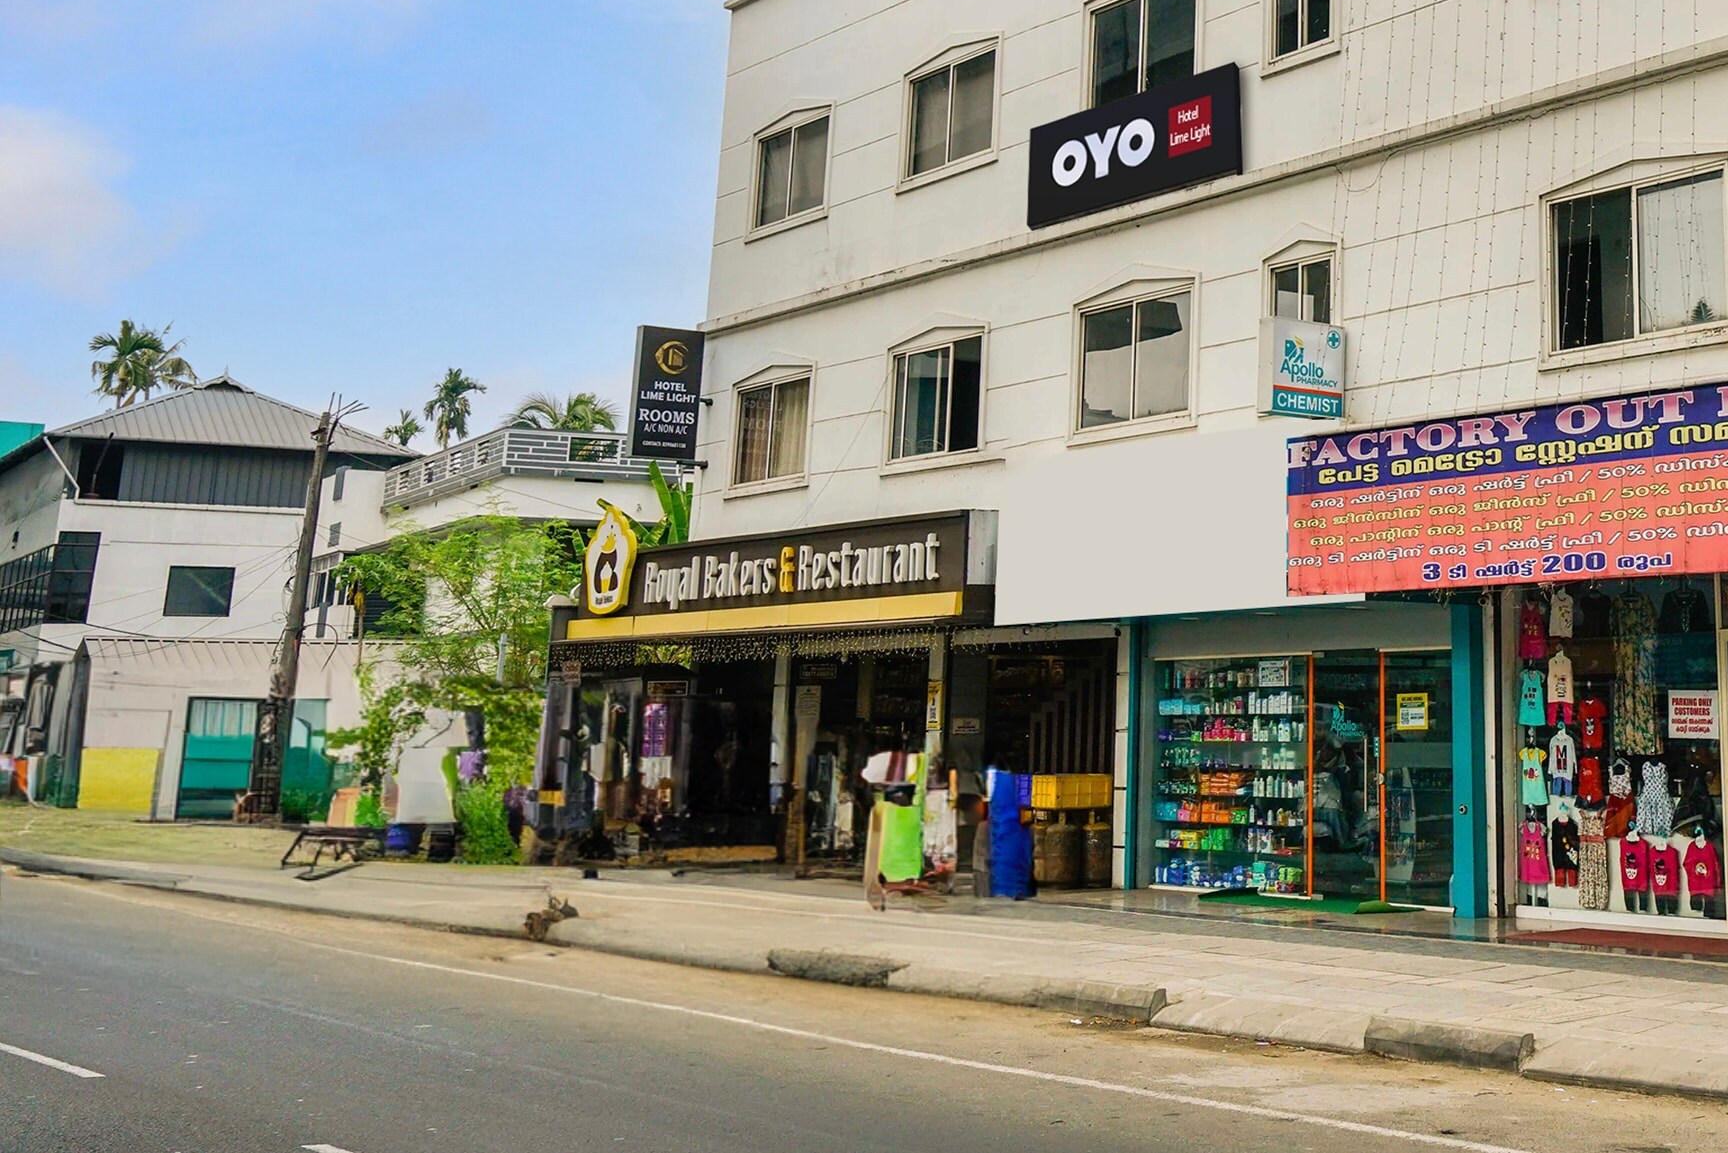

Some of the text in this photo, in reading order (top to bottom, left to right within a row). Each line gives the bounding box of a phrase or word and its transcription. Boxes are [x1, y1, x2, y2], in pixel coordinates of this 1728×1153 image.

[1177, 104, 1199, 125] Hotel
[1170, 124, 1211, 146] Lime Light
[1052, 118, 1155, 187] OYO
[1280, 358, 1324, 382] Apollo
[654, 381, 687, 392] HOTEL
[1296, 376, 1338, 388] PHARMACY
[641, 391, 696, 404] LIME LIGHT
[1277, 392, 1339, 414] CHEMIST
[638, 408, 695, 425] ROOMS
[644, 423, 688, 435] A/C NON A/C
[1287, 411, 1536, 469] FACTORY
[1555, 390, 1694, 436] OUT
[1318, 463, 1379, 485] പേട്ട
[1391, 448, 1503, 477] മെട്രോ
[1310, 496, 1345, 509] ഒരു
[1428, 483, 1467, 497] ഒരു
[1597, 464, 1647, 479] 50%
[1293, 517, 1327, 530] ഒരു
[1428, 503, 1467, 517] ഒരു
[1620, 482, 1671, 499] 50%
[1310, 534, 1345, 547] ഒരു
[1427, 524, 1466, 537] ഒരു
[1599, 507, 1648, 523] 50%
[1288, 555, 1323, 568] ഒരു
[1327, 551, 1345, 564] ടി
[1428, 543, 1467, 556] ഒരു
[1473, 539, 1493, 553] ടി
[1627, 525, 1678, 542] 50%
[643, 532, 940, 611] Royal Bakers & Restaurant
[1422, 562, 1442, 583] 3
[1542, 551, 1607, 576] 200
[1671, 697, 1712, 706] PARKING ONLY
[1674, 707, 1711, 716] CUSTOMERS
